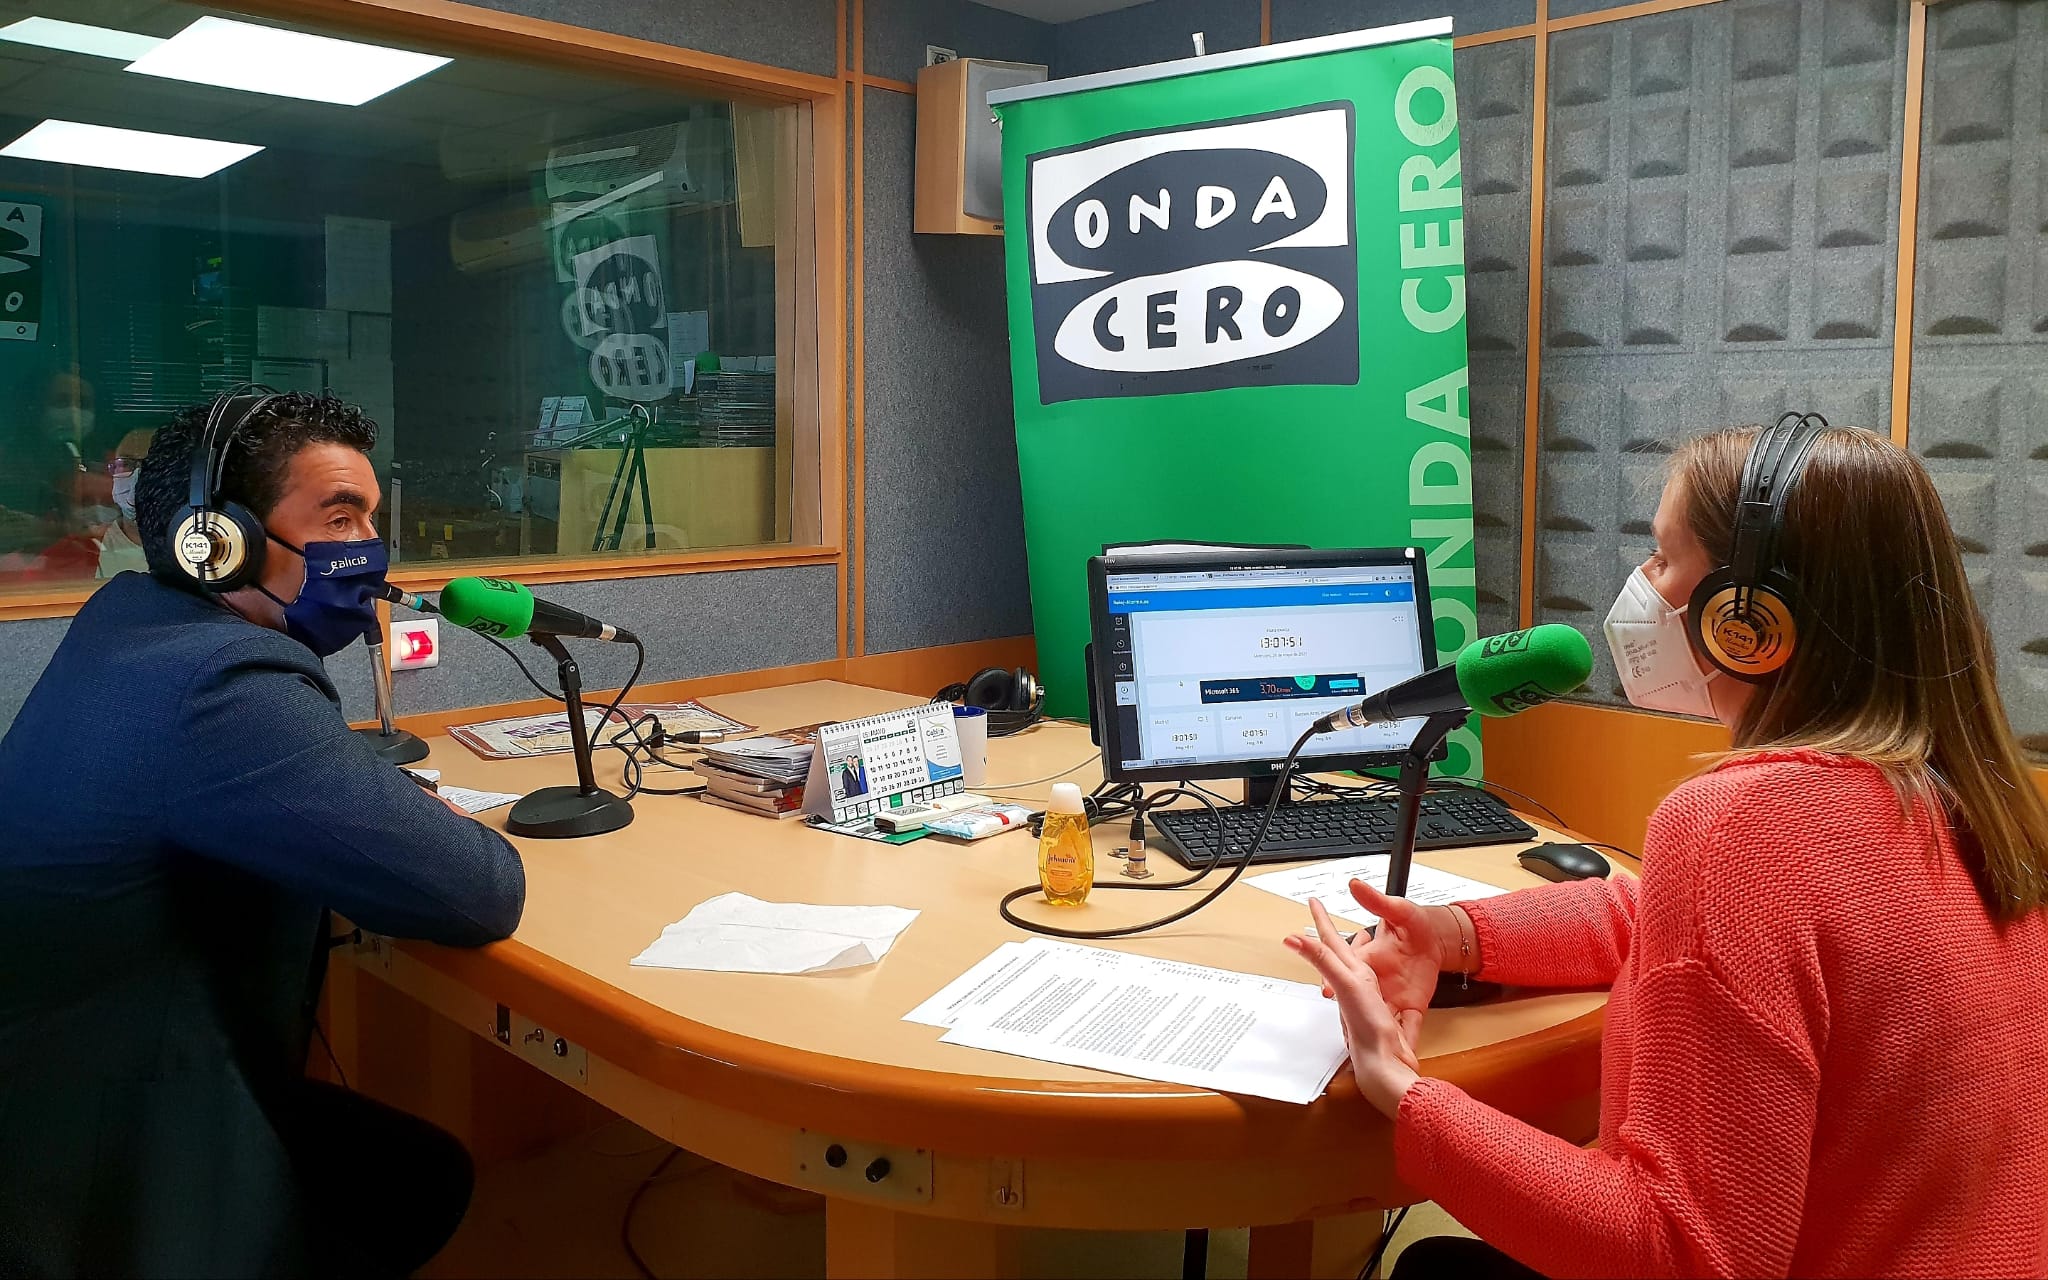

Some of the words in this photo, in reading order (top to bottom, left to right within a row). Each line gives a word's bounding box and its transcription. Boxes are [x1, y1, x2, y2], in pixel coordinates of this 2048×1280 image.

[1394, 66, 1466, 333] CERO
[1074, 175, 1297, 249] ONDA
[1093, 285, 1301, 352] CERO
[1406, 366, 1478, 665] ONDA
[320, 556, 368, 576] galicia
[1260, 636, 1302, 648] 13:07:51
[1723, 628, 1753, 645] K141
[1205, 687, 1228, 695] Microsoft
[1271, 762, 1300, 771] PHIPS
